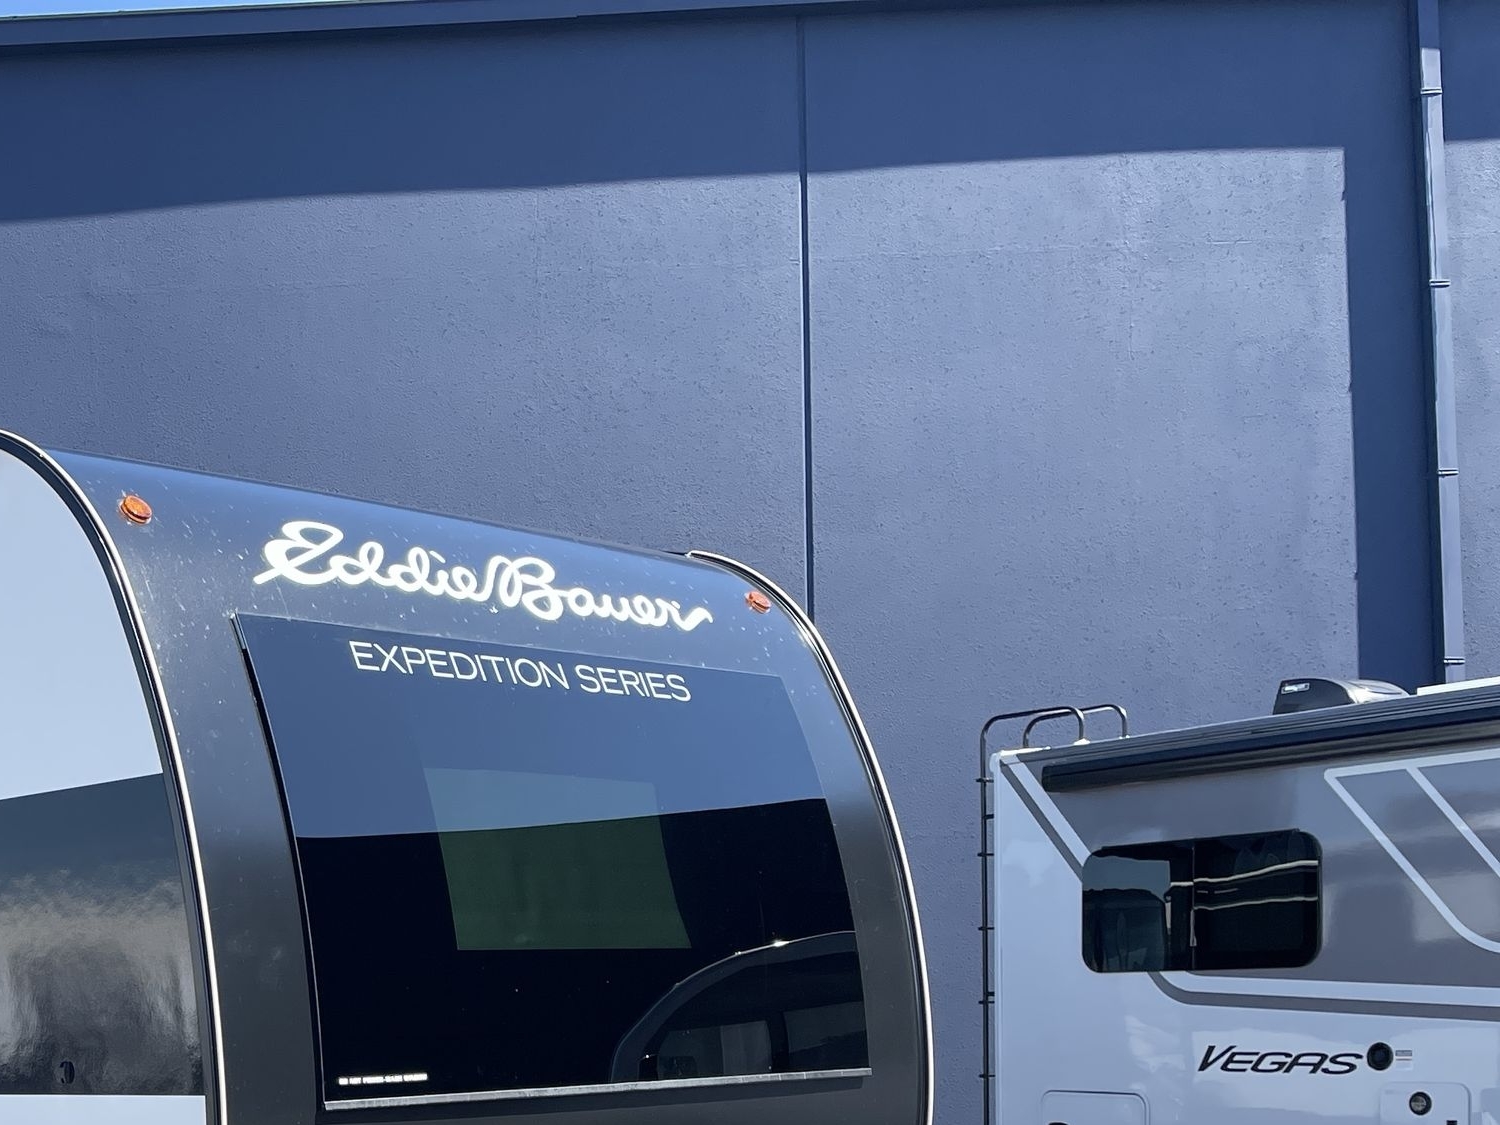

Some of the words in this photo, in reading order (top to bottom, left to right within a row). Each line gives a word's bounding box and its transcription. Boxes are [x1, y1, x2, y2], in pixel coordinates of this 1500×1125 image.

[253, 521, 491, 602] Eddie
[488, 555, 713, 631] Bauer
[349, 640, 570, 691] EXPEDITION
[574, 663, 692, 702] SERIES
[1197, 1044, 1364, 1075] VEGAS
